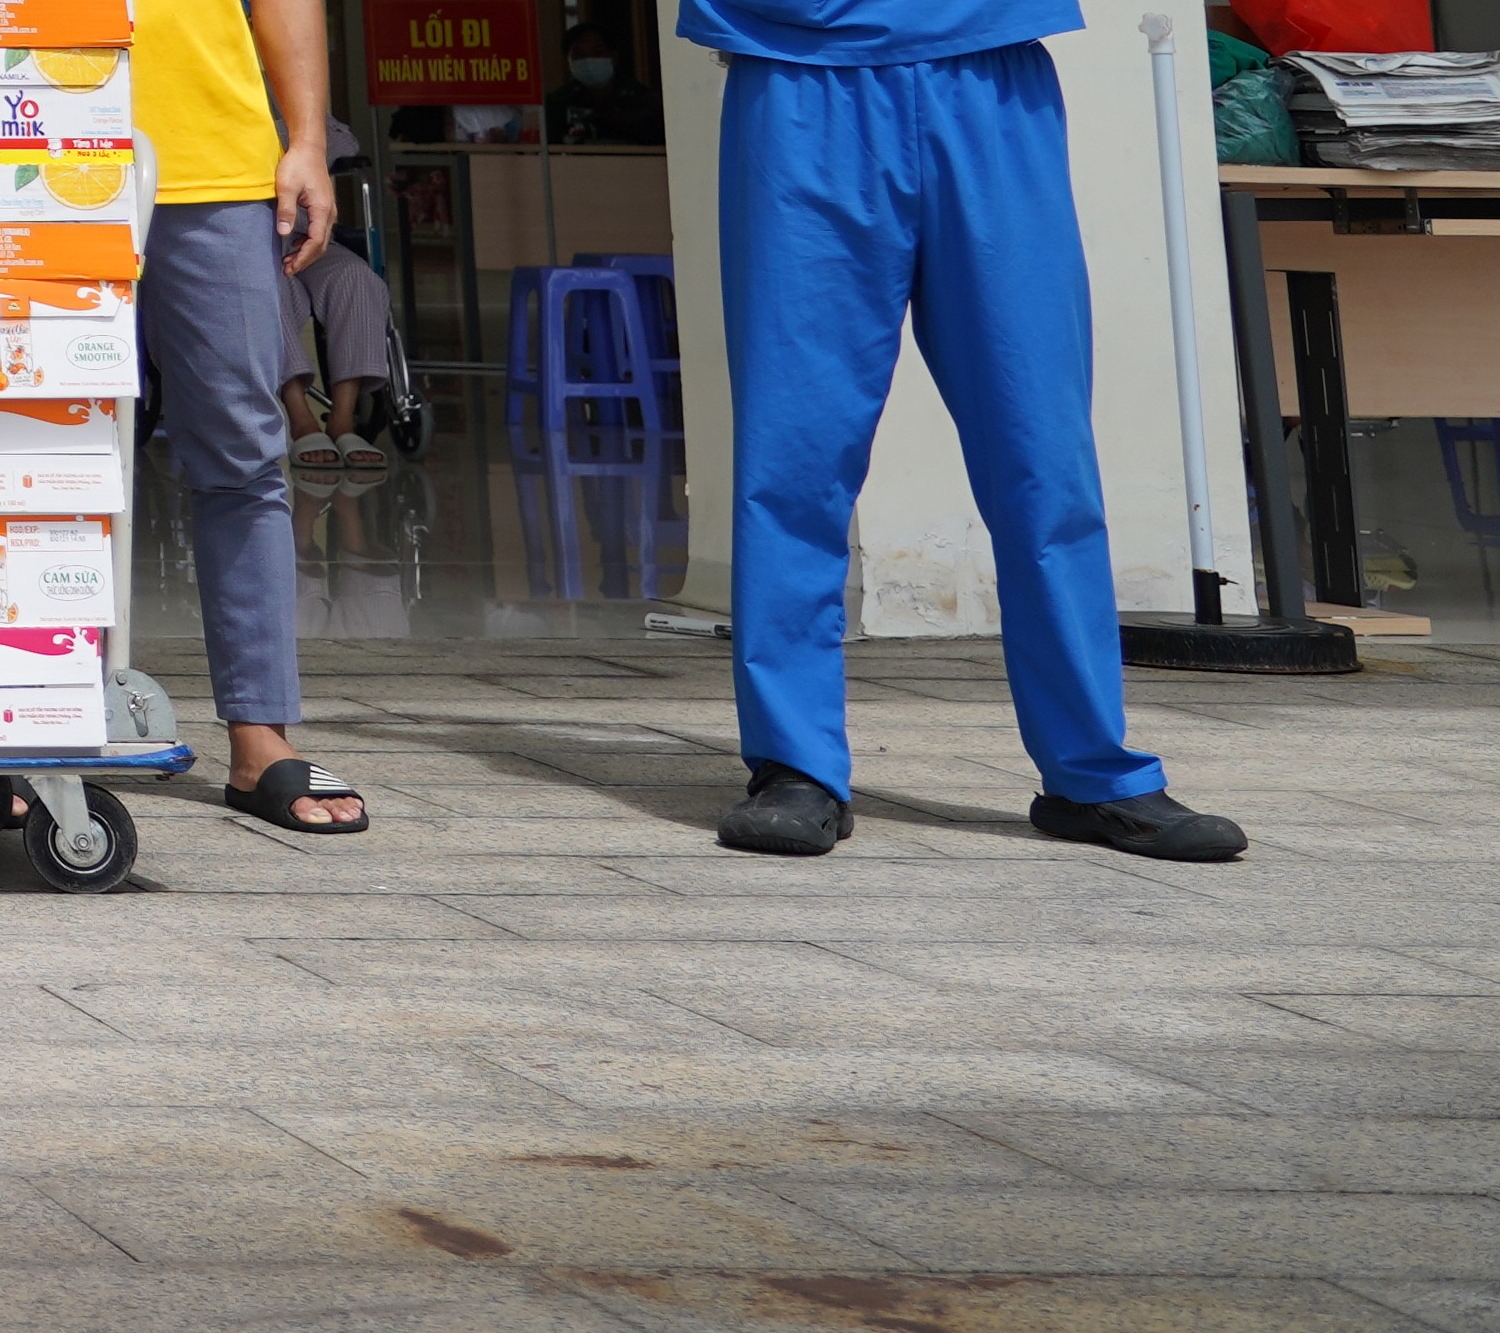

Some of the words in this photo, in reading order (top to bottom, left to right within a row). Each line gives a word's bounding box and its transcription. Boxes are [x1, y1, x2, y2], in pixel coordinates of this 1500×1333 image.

[409, 9, 454, 48] LỐI
[461, 19, 490, 47] ĐI
[378, 55, 425, 82] NHÂN
[428, 55, 466, 82] VIÊN
[469, 53, 511, 81] THÁP
[517, 60, 528, 81] B
